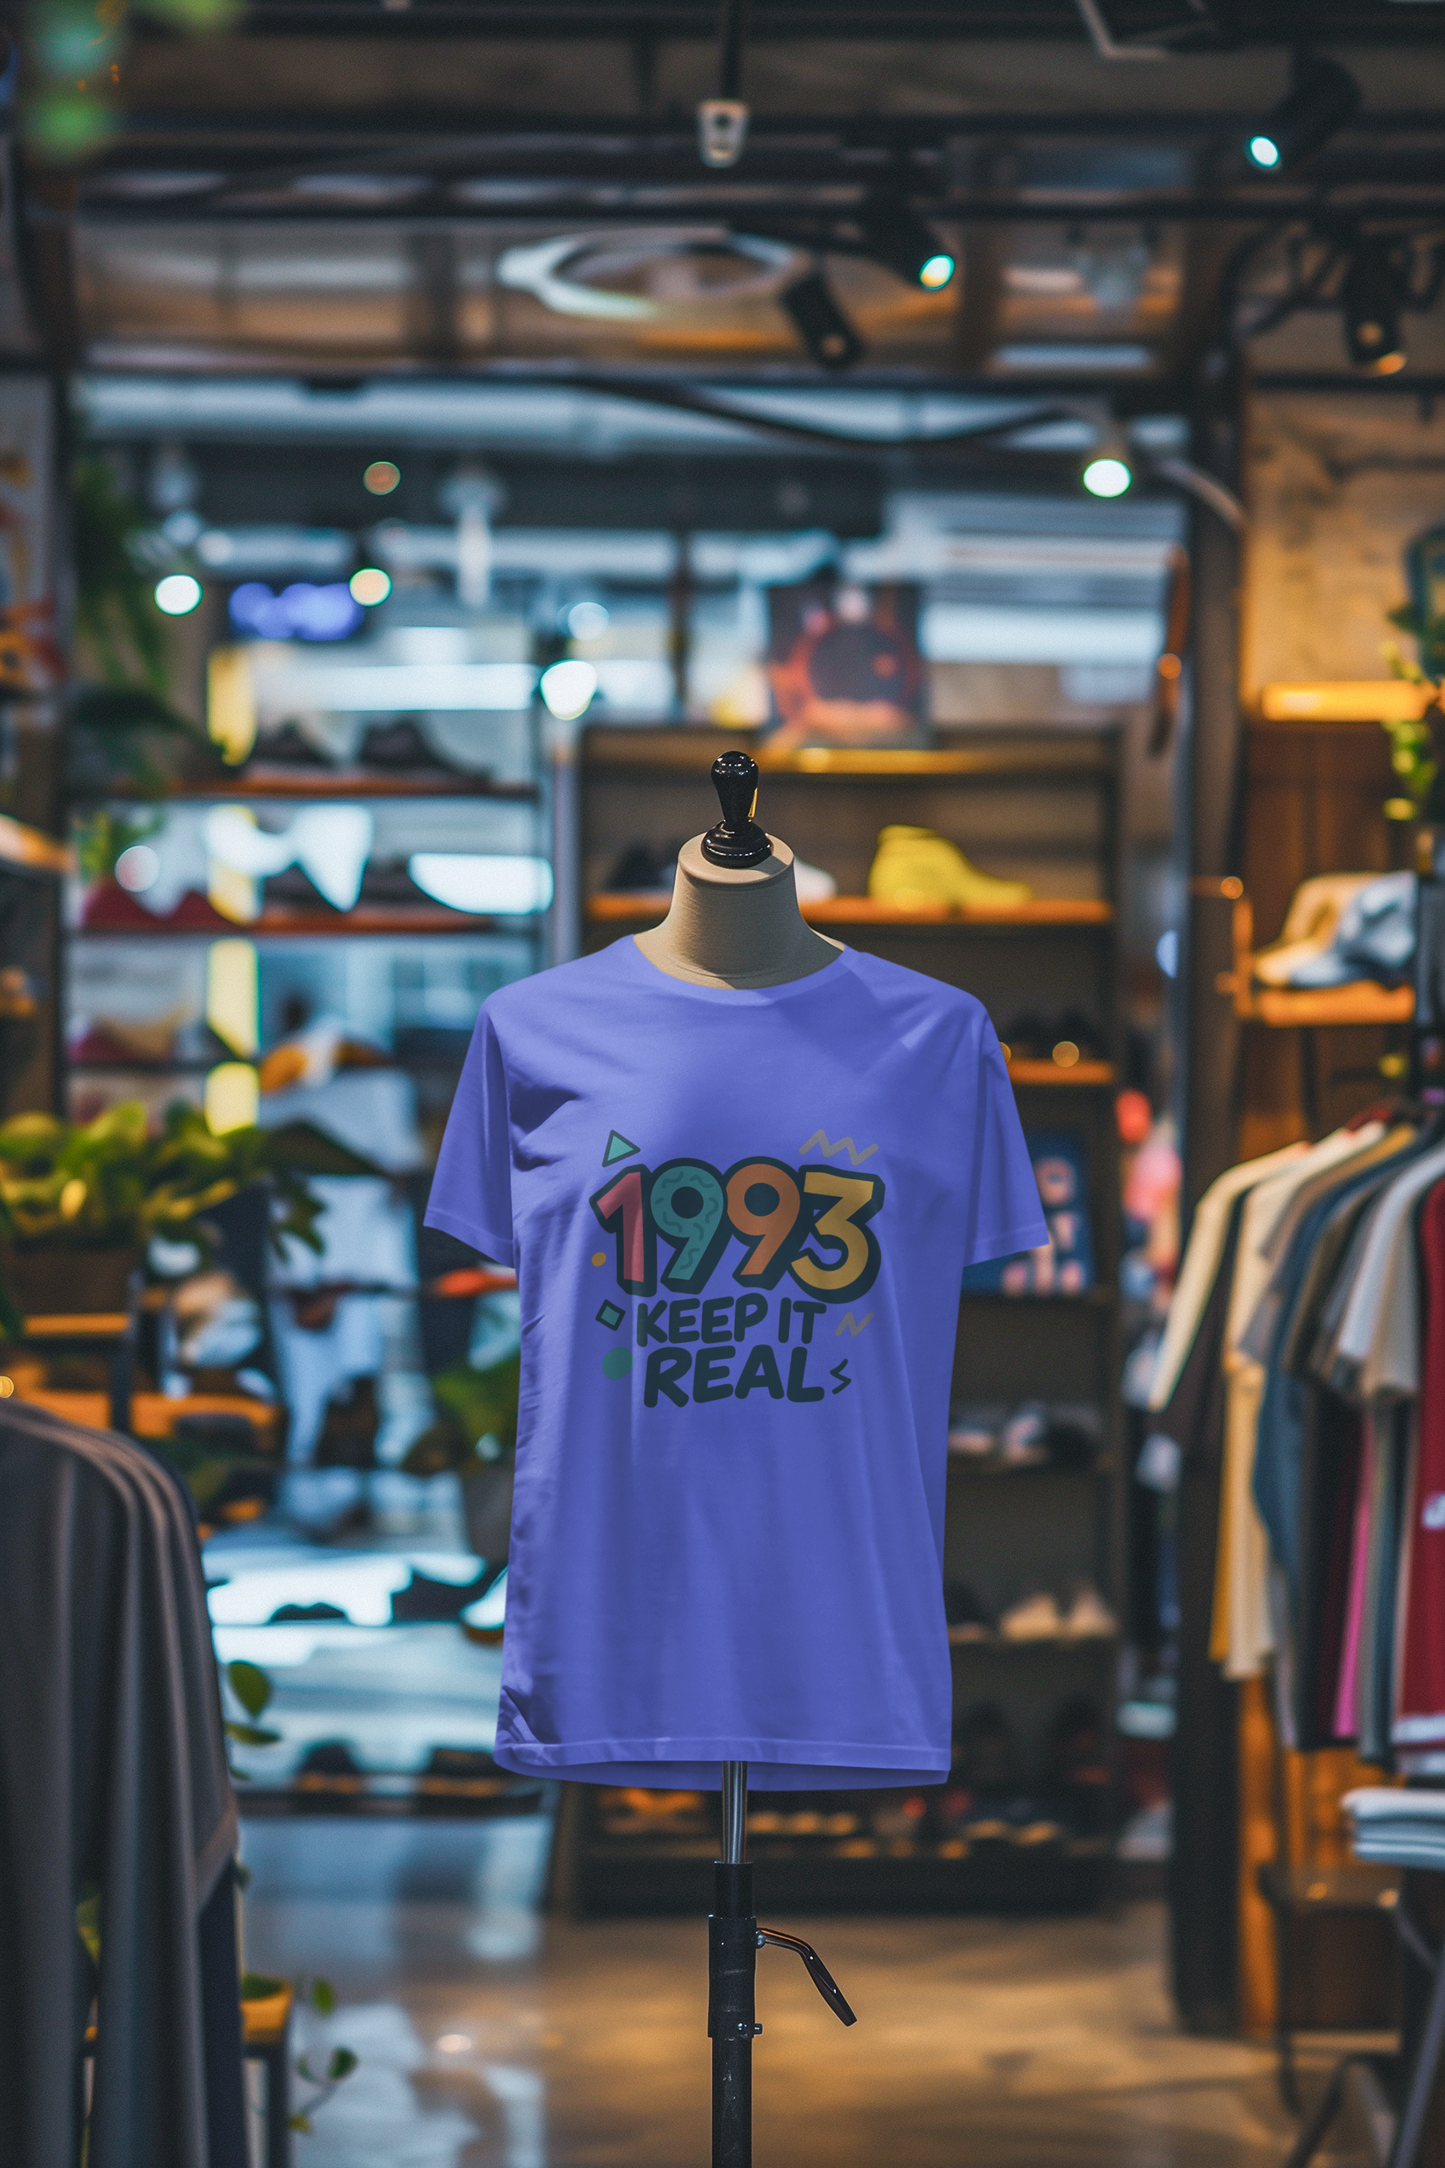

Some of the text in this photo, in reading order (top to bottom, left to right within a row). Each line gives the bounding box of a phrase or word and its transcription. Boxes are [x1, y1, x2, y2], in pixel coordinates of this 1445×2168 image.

[589, 1156, 886, 1304] 1993
[636, 1292, 827, 1348] KEEP IT
[643, 1344, 825, 1408] REAL
